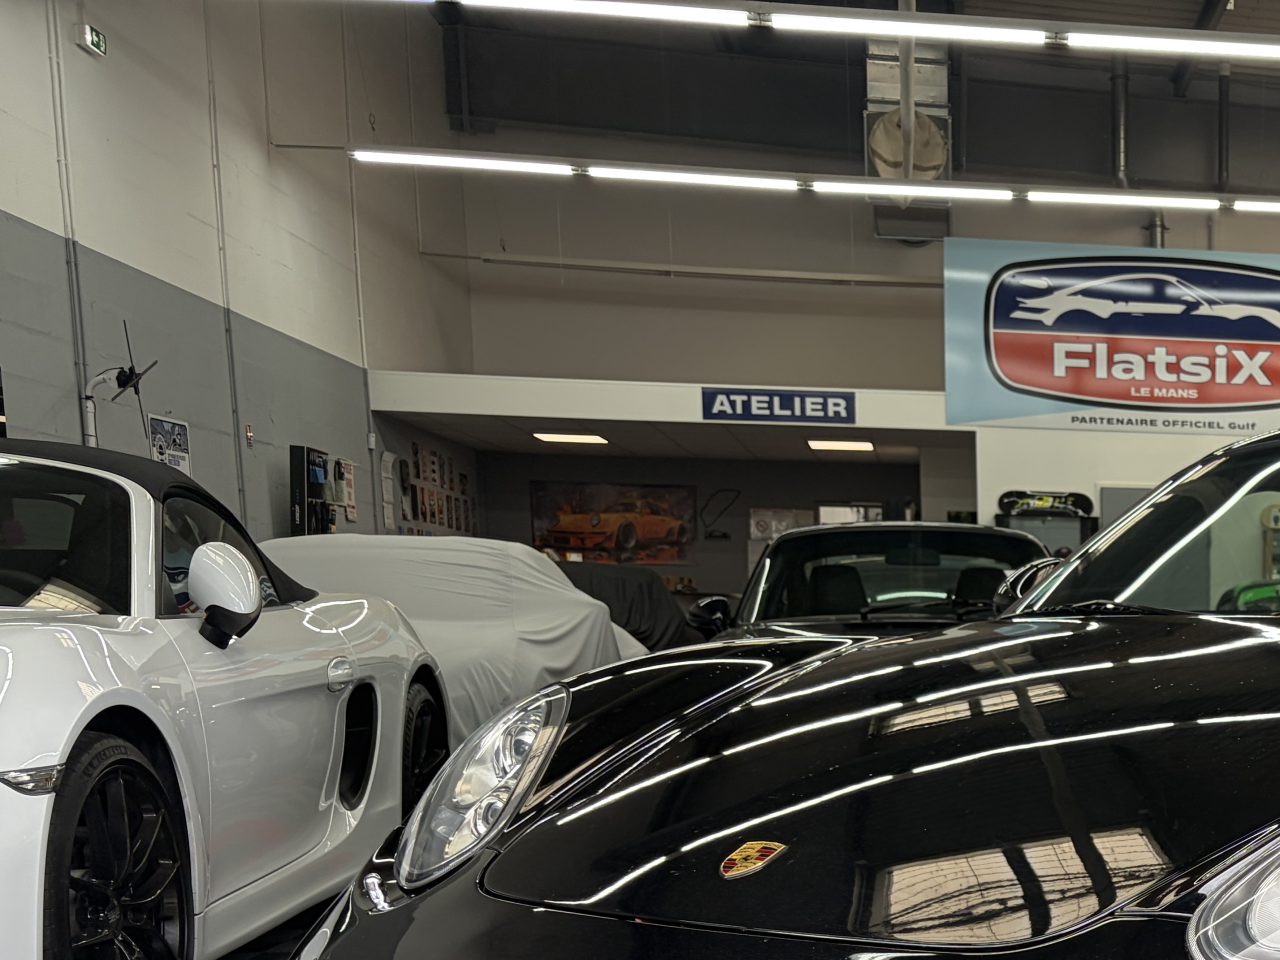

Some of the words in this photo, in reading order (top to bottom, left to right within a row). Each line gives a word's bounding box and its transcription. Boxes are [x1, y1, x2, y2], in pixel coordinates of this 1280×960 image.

[1130, 386, 1151, 397] LE
[1153, 387, 1199, 399] MANS
[711, 394, 848, 418] ATELIER
[1071, 415, 1158, 427] PARTENAIRE
[1162, 418, 1225, 430] OFFICIEL
[1228, 421, 1256, 431] Gulf
